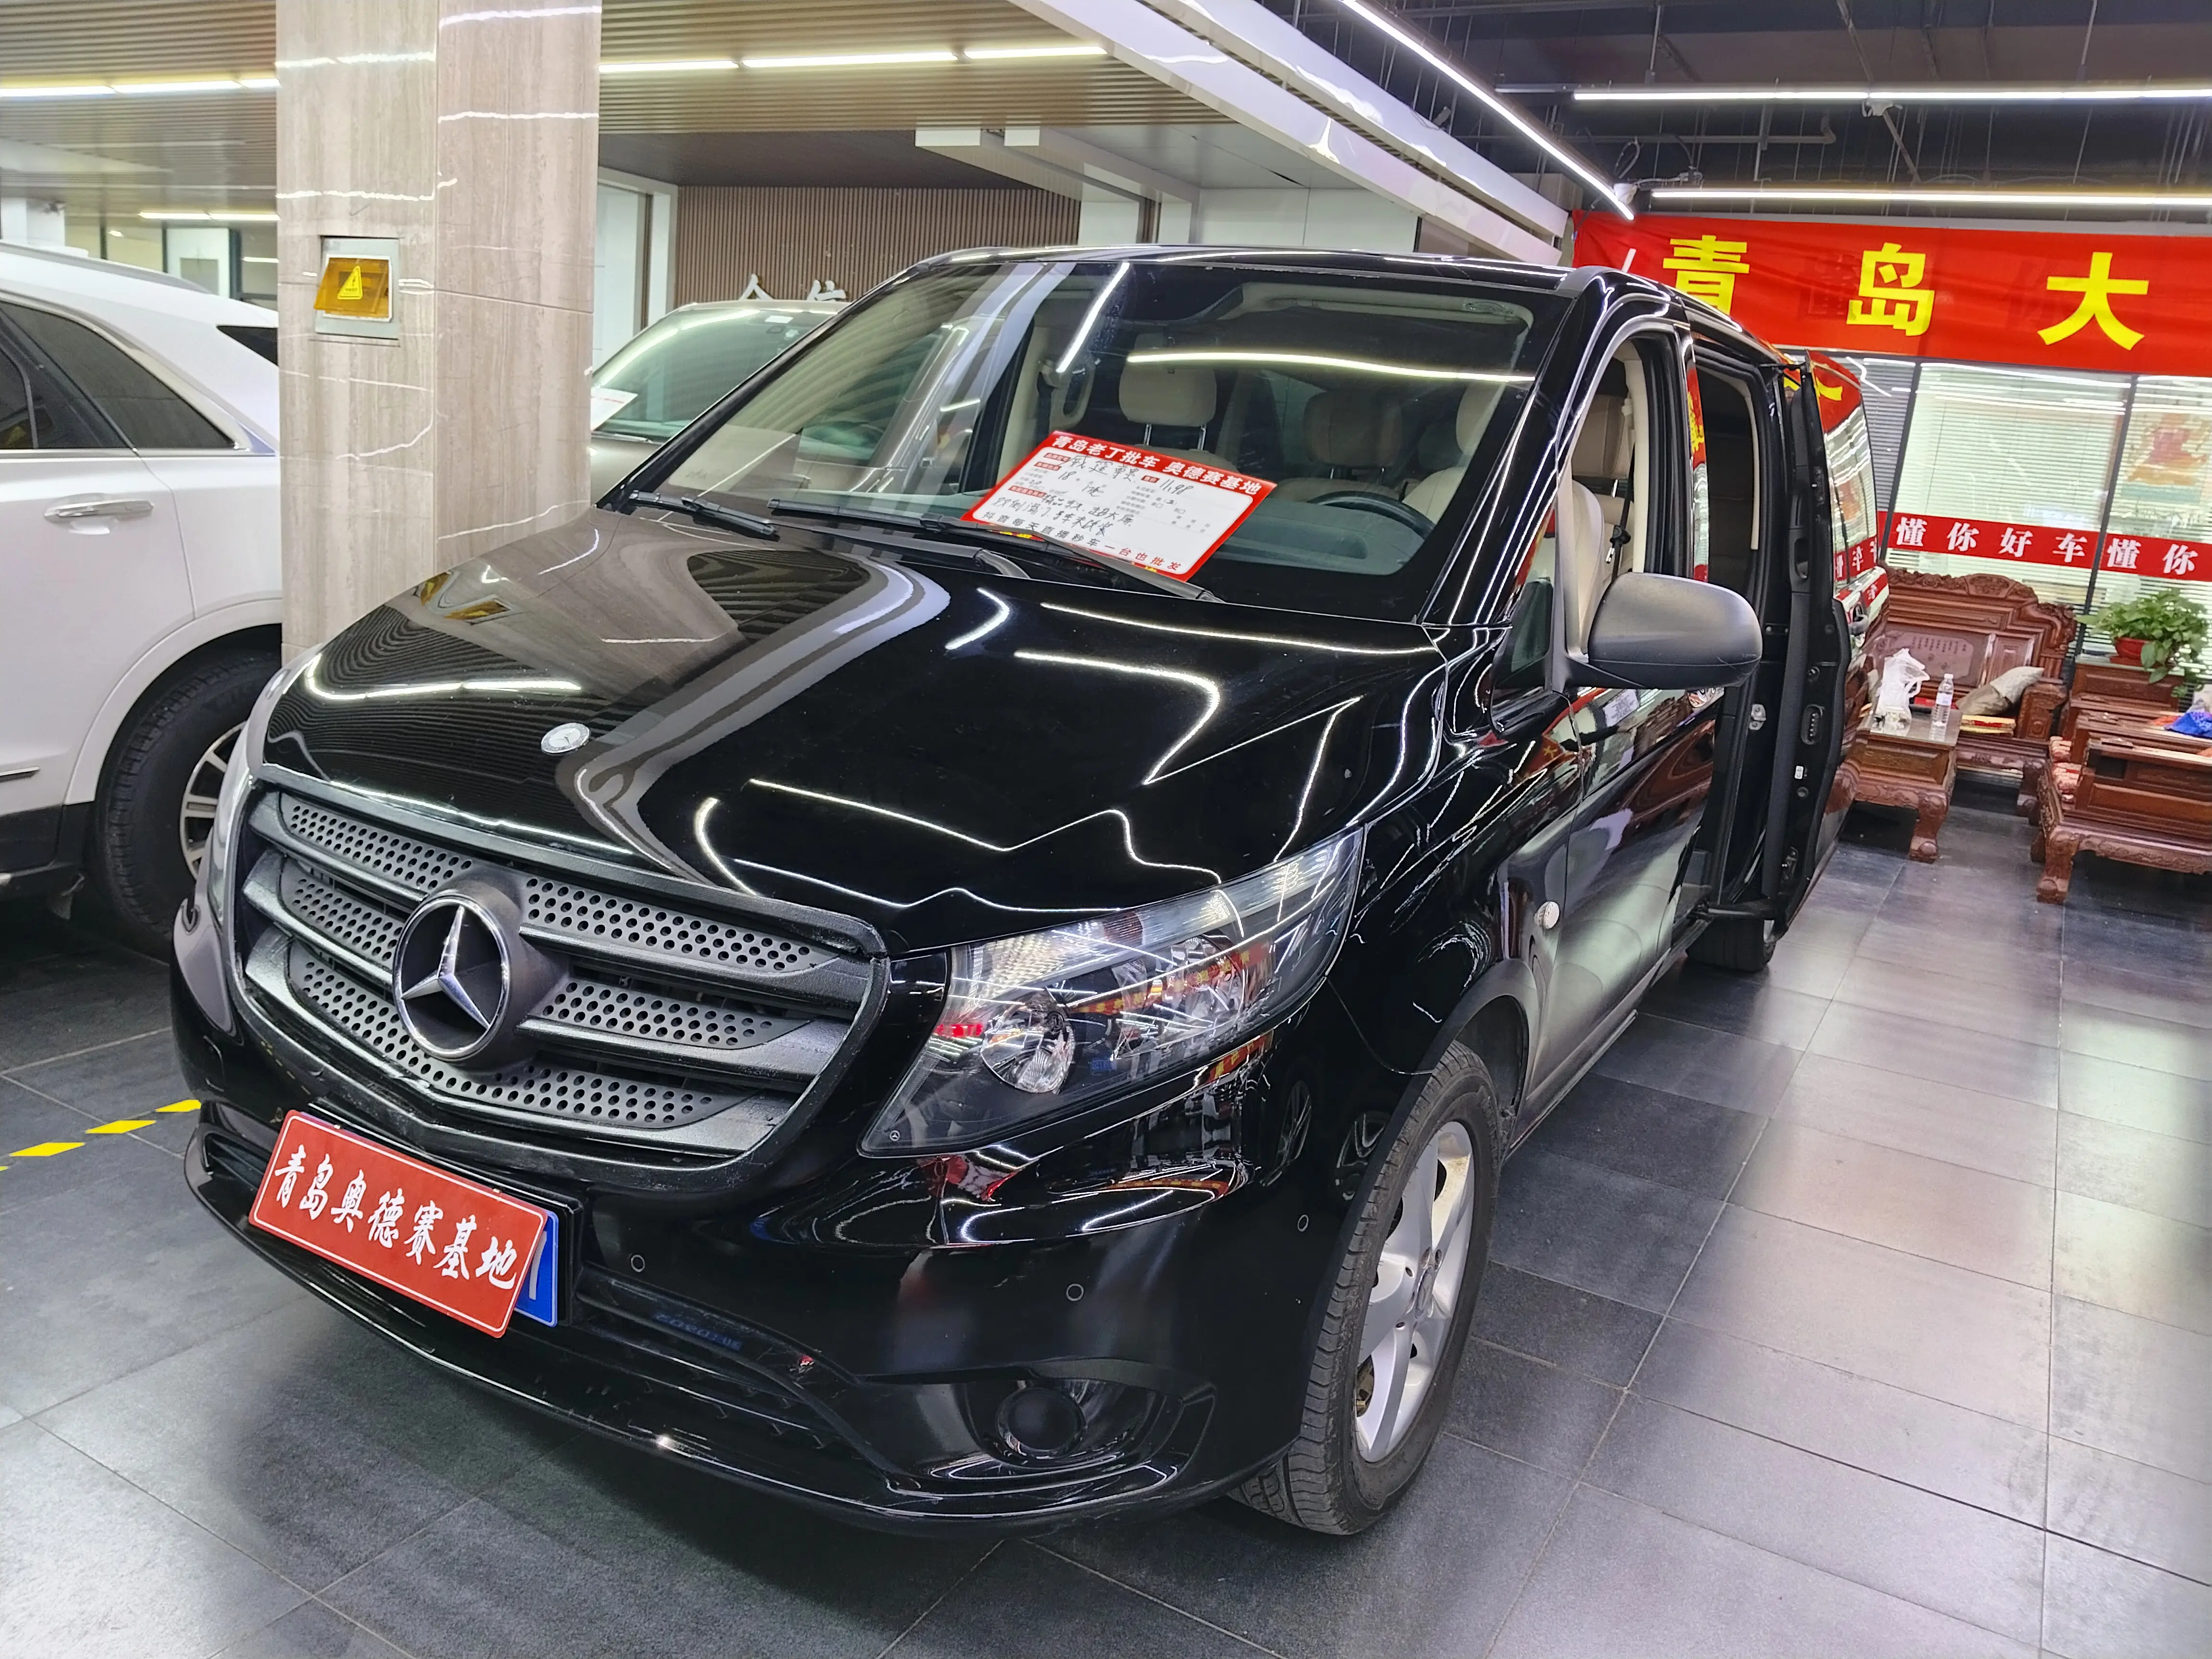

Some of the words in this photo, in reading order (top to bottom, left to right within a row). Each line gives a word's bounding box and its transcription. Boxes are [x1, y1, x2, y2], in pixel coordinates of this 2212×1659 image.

[1050, 436, 1162, 469] 青岛老丁批车
[1162, 463, 1259, 494] 奥德赛基地
[275, 1144, 517, 1289] 青岛奥德赛基地
